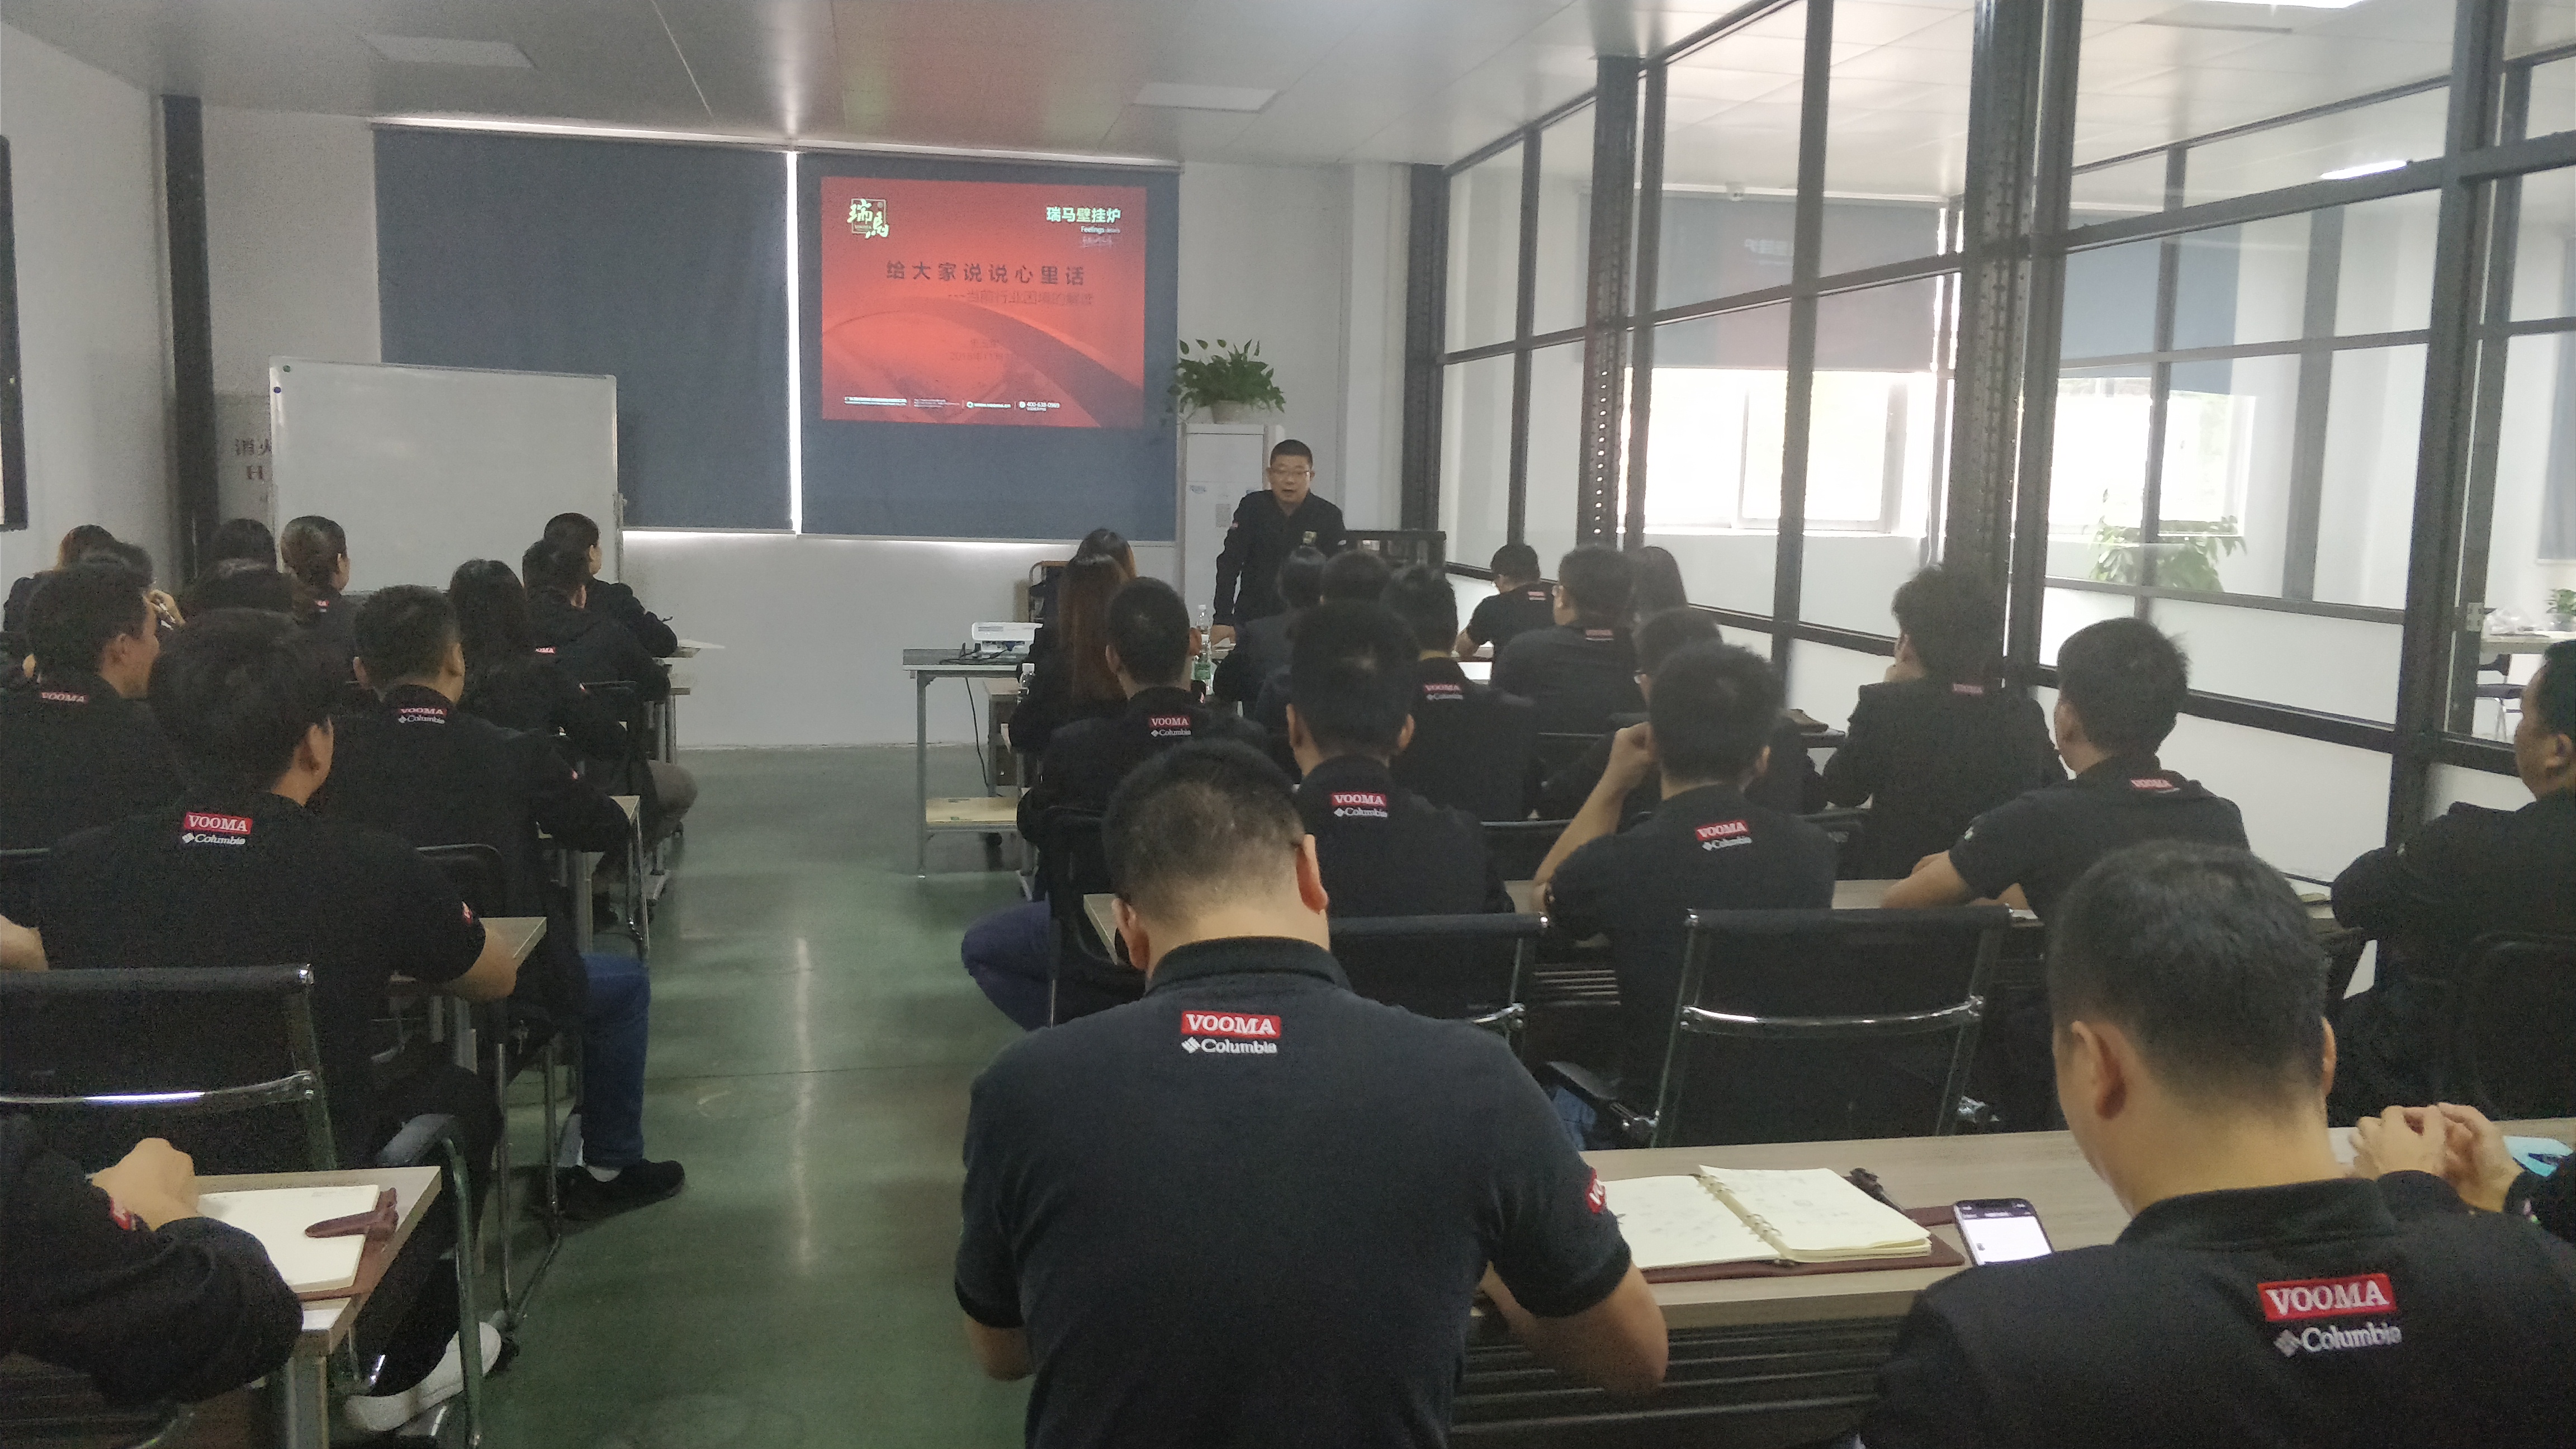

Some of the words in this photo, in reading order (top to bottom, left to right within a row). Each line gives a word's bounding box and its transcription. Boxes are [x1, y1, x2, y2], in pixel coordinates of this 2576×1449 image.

[1046, 207, 1121, 223] 瑞马壁挂炉
[887, 261, 1085, 286] 给大家说说心里话
[41, 692, 84, 703] VOOMA
[407, 714, 445, 724] Columbia
[1151, 717, 1189, 726] VOOMA
[1333, 794, 1385, 806] VOOMA
[1344, 807, 1388, 818] Columbia
[188, 815, 248, 832] VOOMA
[1697, 822, 1748, 837] VOOMA
[195, 834, 246, 845] Columbia
[1186, 1014, 1277, 1035] VOOMA
[1201, 1038, 1278, 1054] Columbia
[2265, 1280, 2390, 1316] VOOMA
[2301, 1322, 2403, 1353] Columbia
